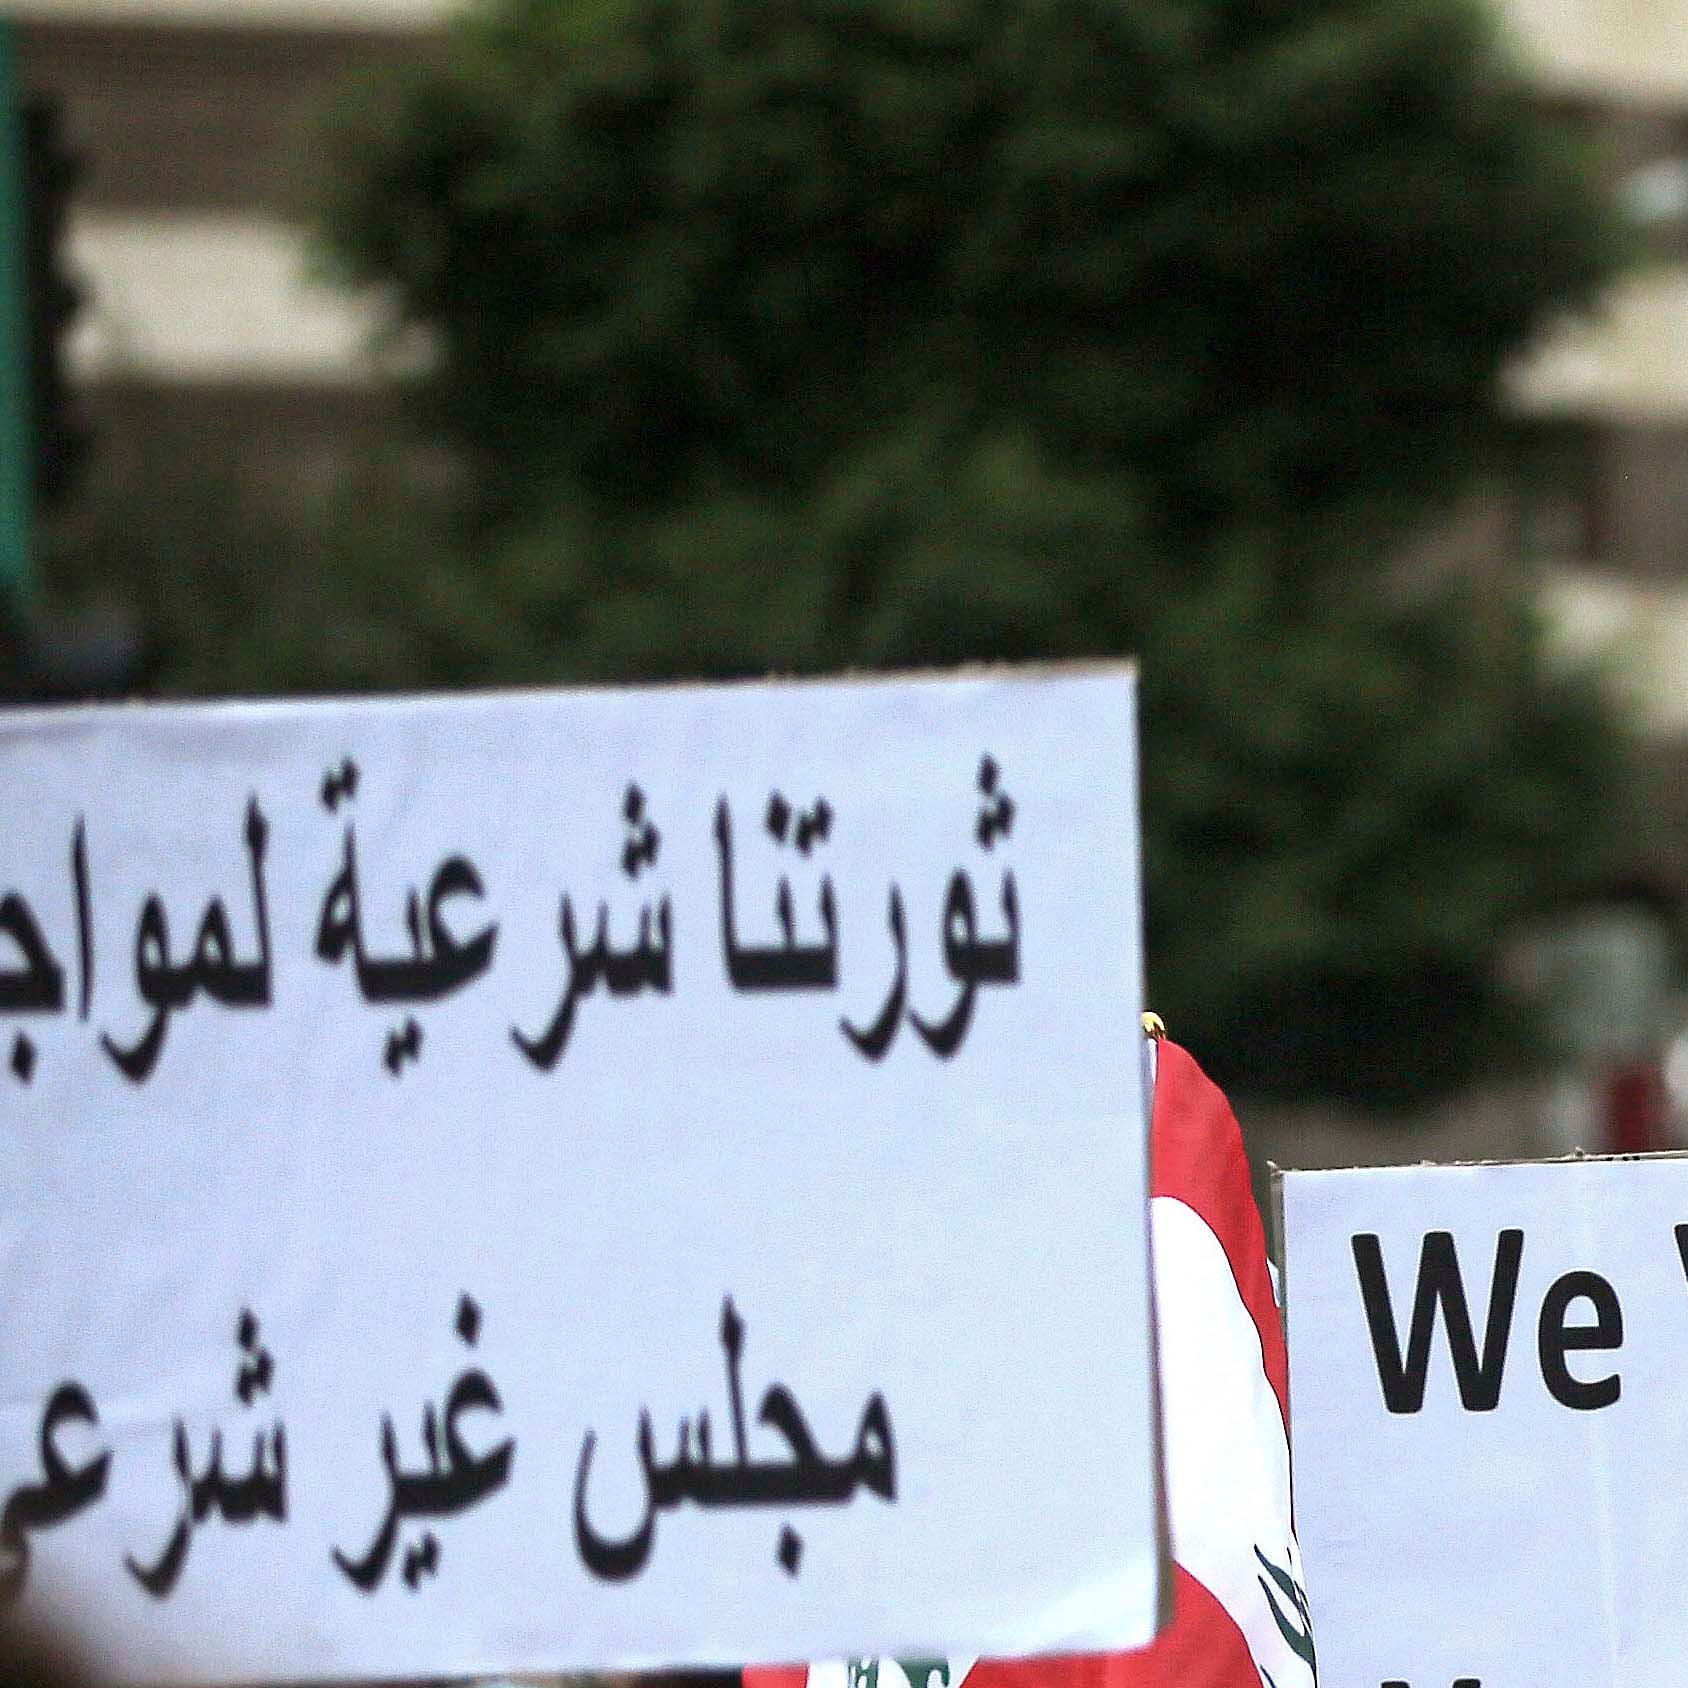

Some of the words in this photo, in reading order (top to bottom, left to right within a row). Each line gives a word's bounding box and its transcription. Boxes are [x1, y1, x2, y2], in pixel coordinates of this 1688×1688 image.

[312, 757, 674, 1076] شرعية
[713, 756, 1021, 1063] ثورتنا
[332, 1292, 516, 1594] غير
[573, 1292, 898, 1584] مجلس
[1350, 1228, 1626, 1414] We
